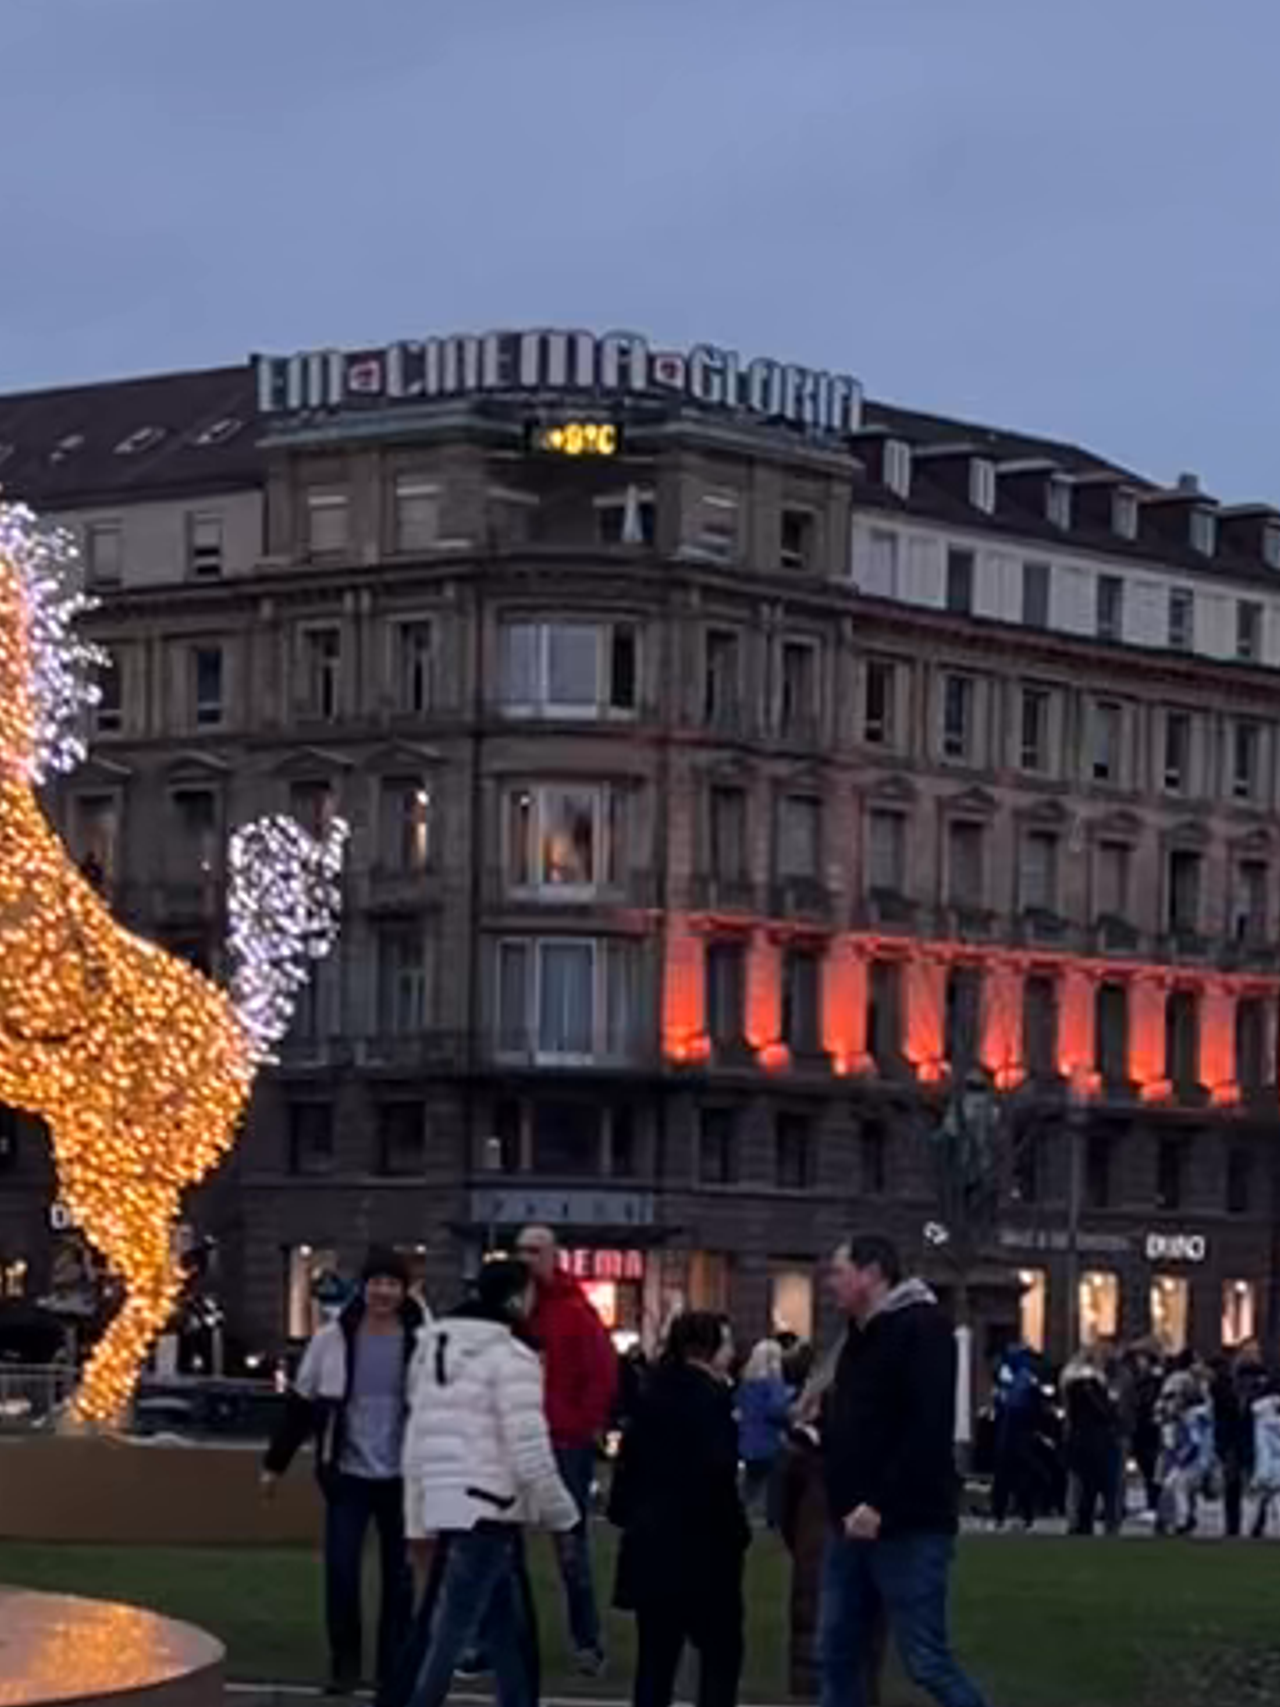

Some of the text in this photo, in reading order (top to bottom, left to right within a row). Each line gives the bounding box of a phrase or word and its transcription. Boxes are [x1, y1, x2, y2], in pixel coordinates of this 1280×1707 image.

[255, 328, 865, 433] EM CINEMA GLORIA
